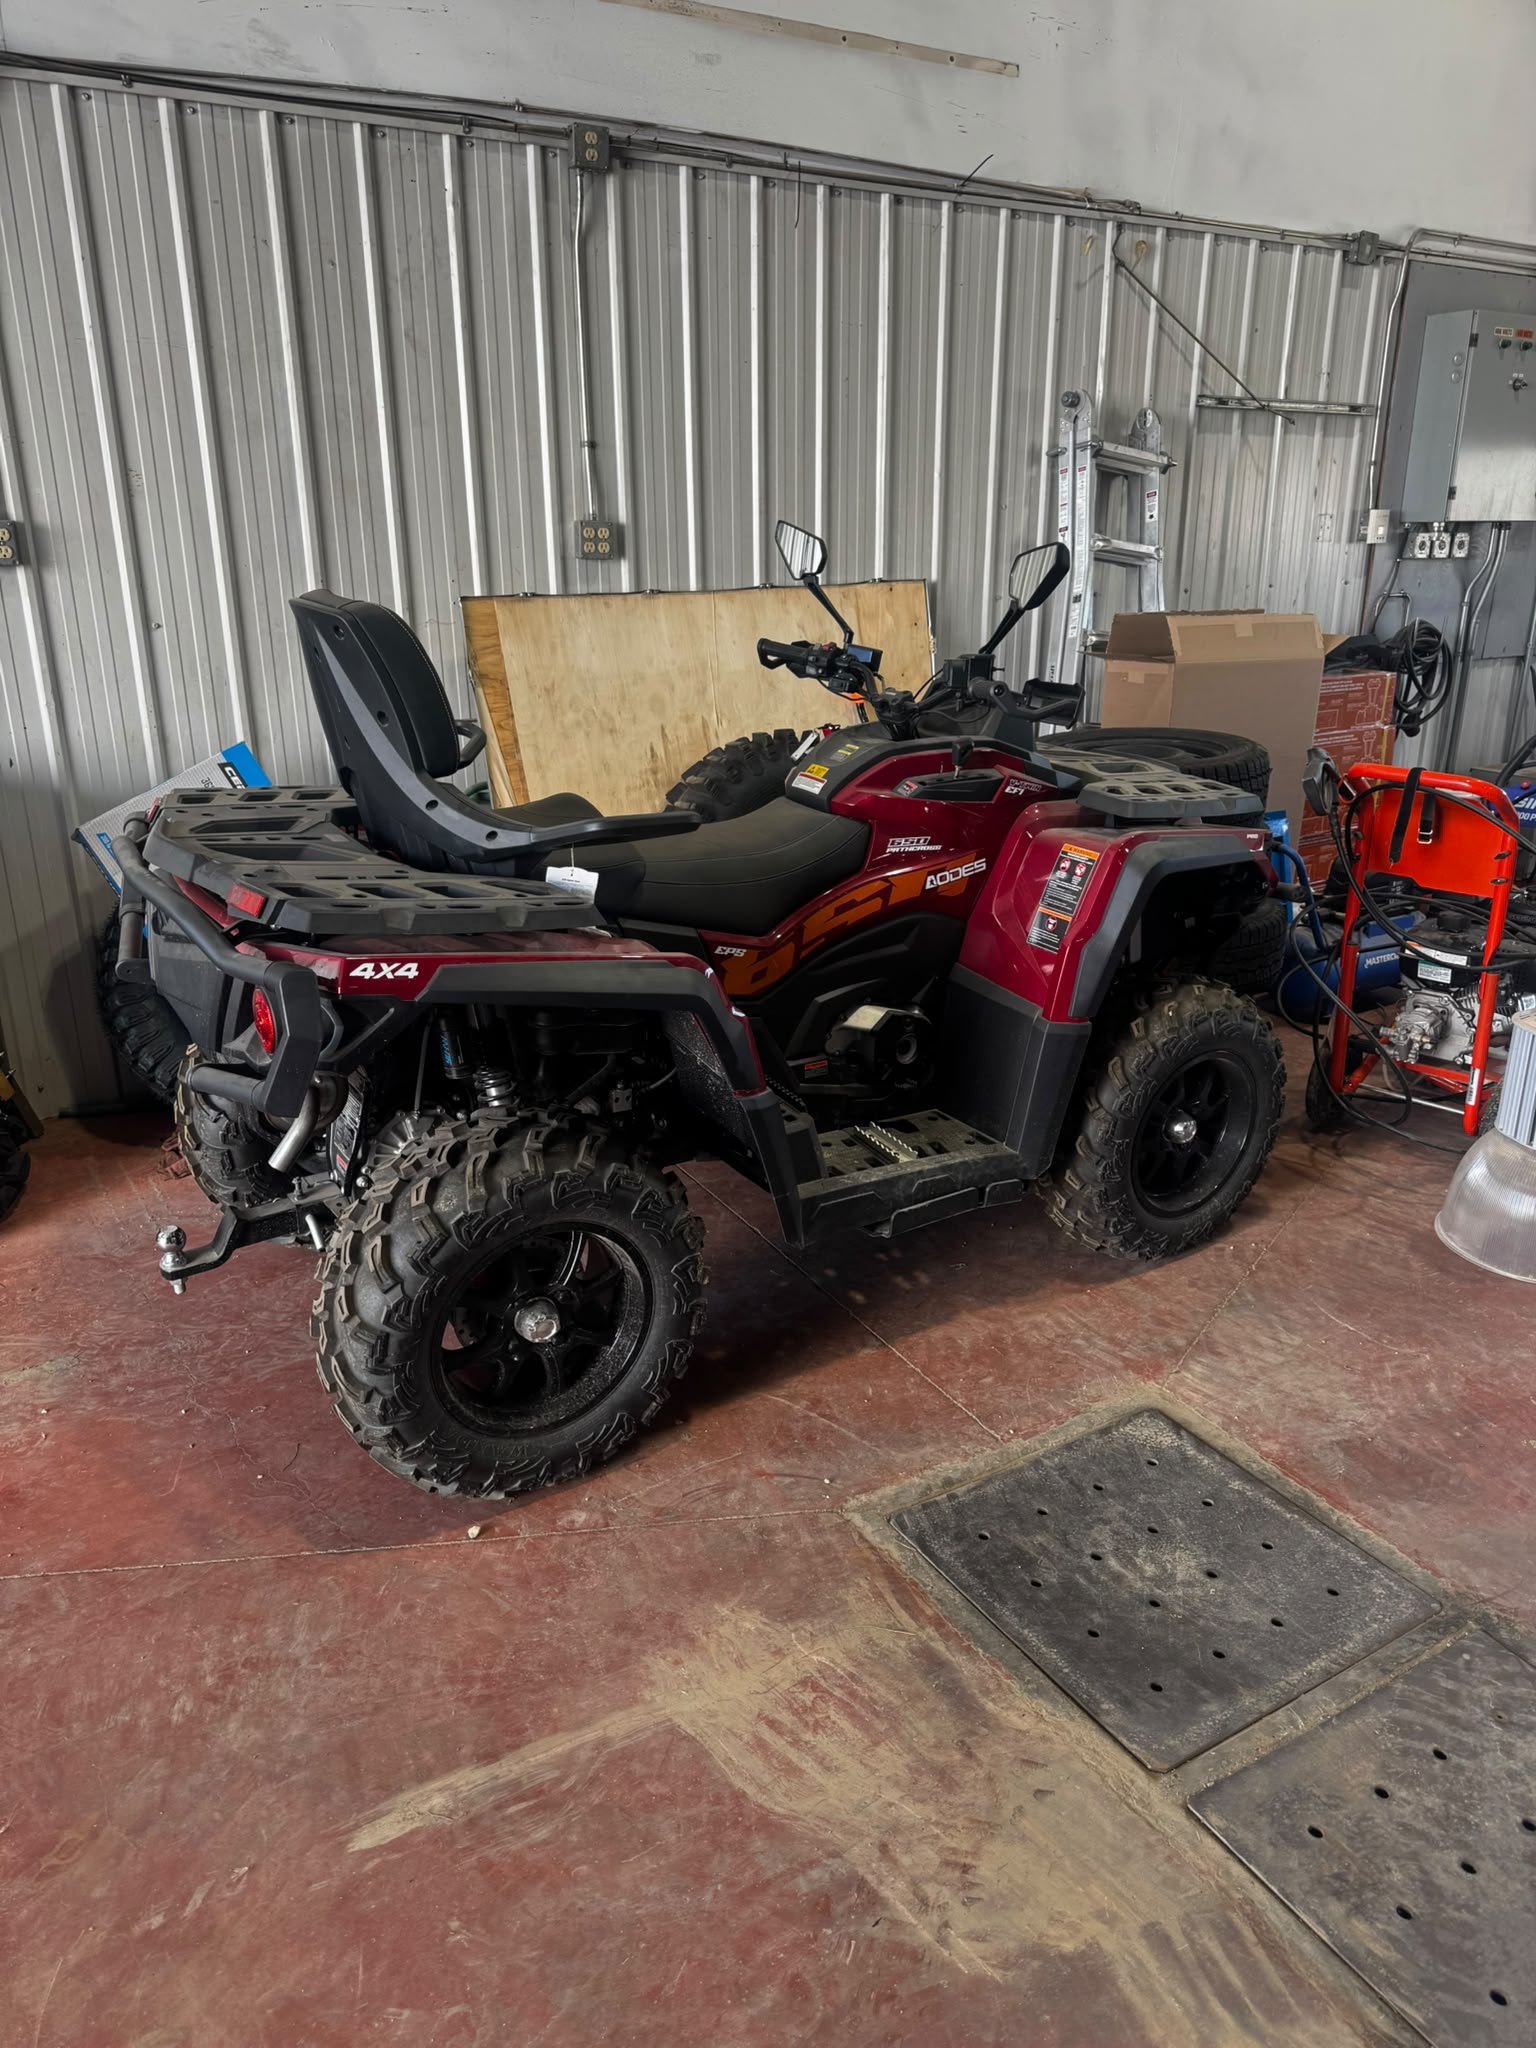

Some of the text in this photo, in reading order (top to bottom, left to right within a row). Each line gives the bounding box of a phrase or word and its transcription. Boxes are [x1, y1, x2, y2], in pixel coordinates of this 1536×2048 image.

[1004, 786, 1025, 796] EFI
[888, 836, 931, 847] 650
[886, 845, 942, 853] PATHCROSS
[925, 858, 986, 890] AODES
[714, 946, 747, 957] EPS
[349, 962, 419, 979] 4X4
